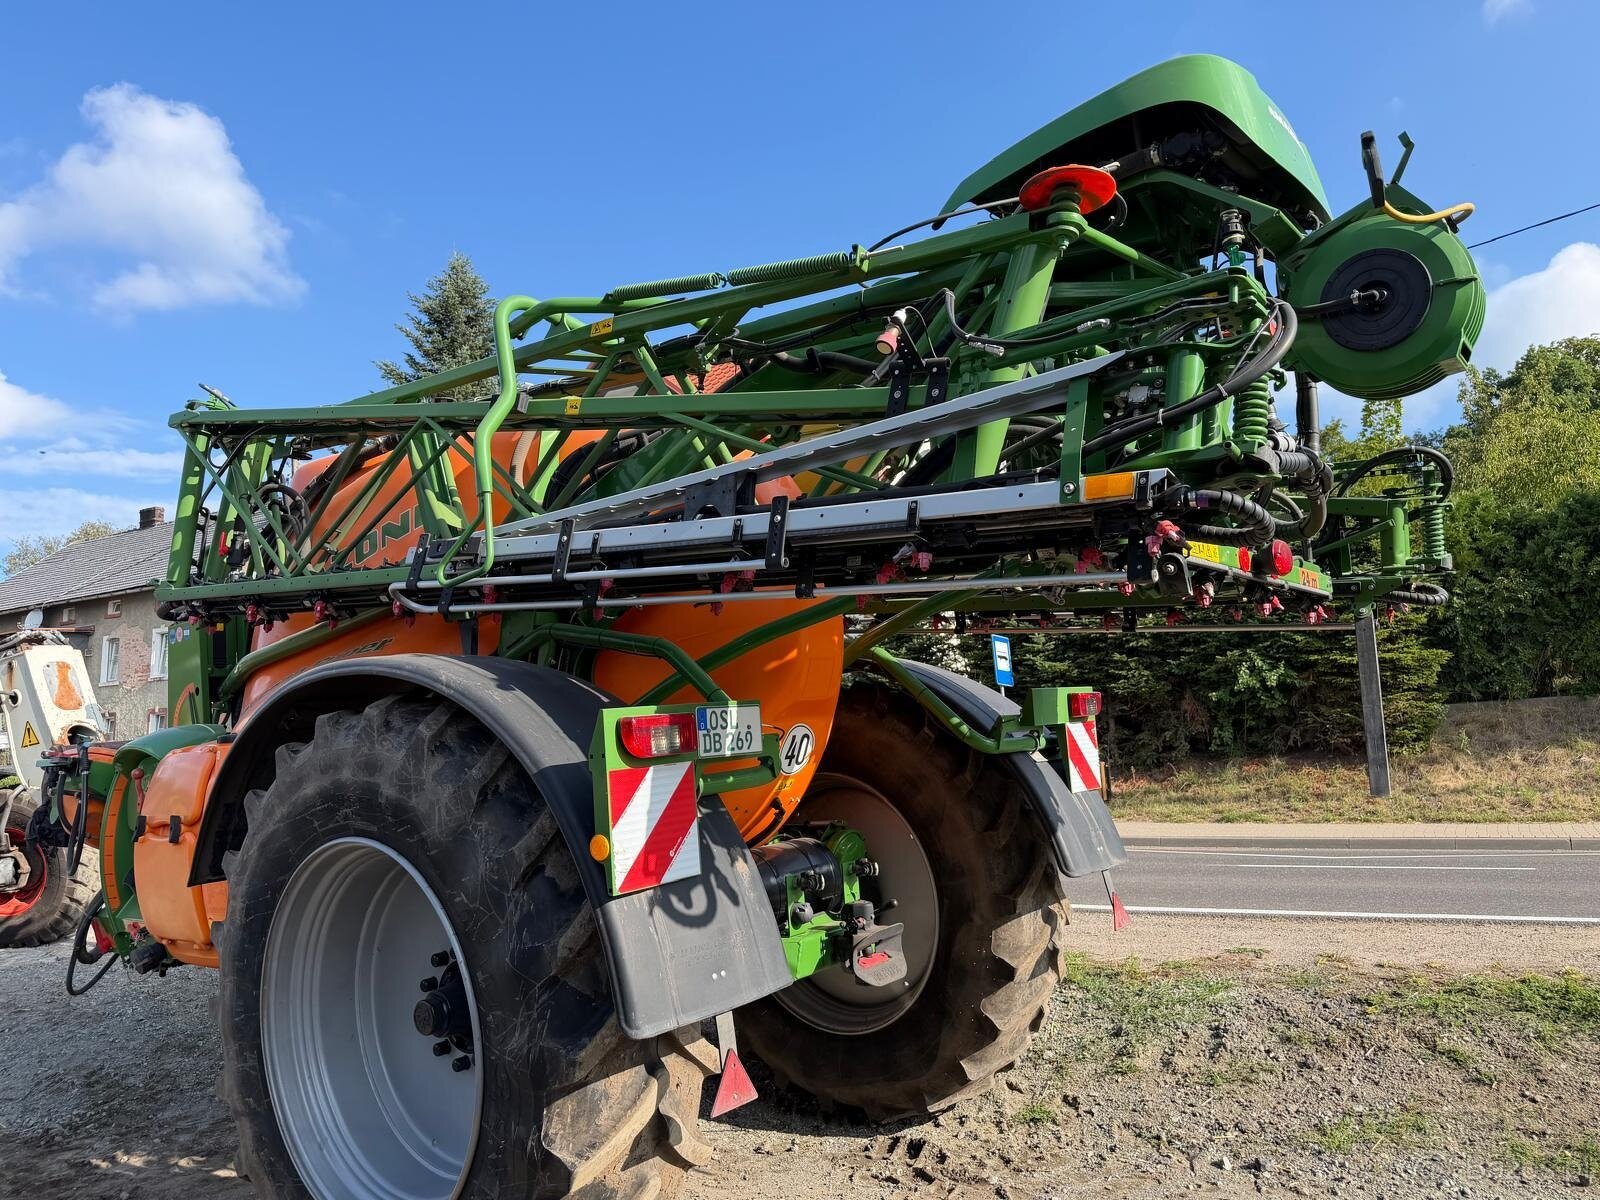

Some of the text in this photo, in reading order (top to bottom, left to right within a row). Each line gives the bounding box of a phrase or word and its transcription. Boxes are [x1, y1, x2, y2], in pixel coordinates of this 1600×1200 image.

[709, 710, 739, 730] OSL
[702, 731, 753, 753] DB 269
[784, 733, 810, 767] 40
